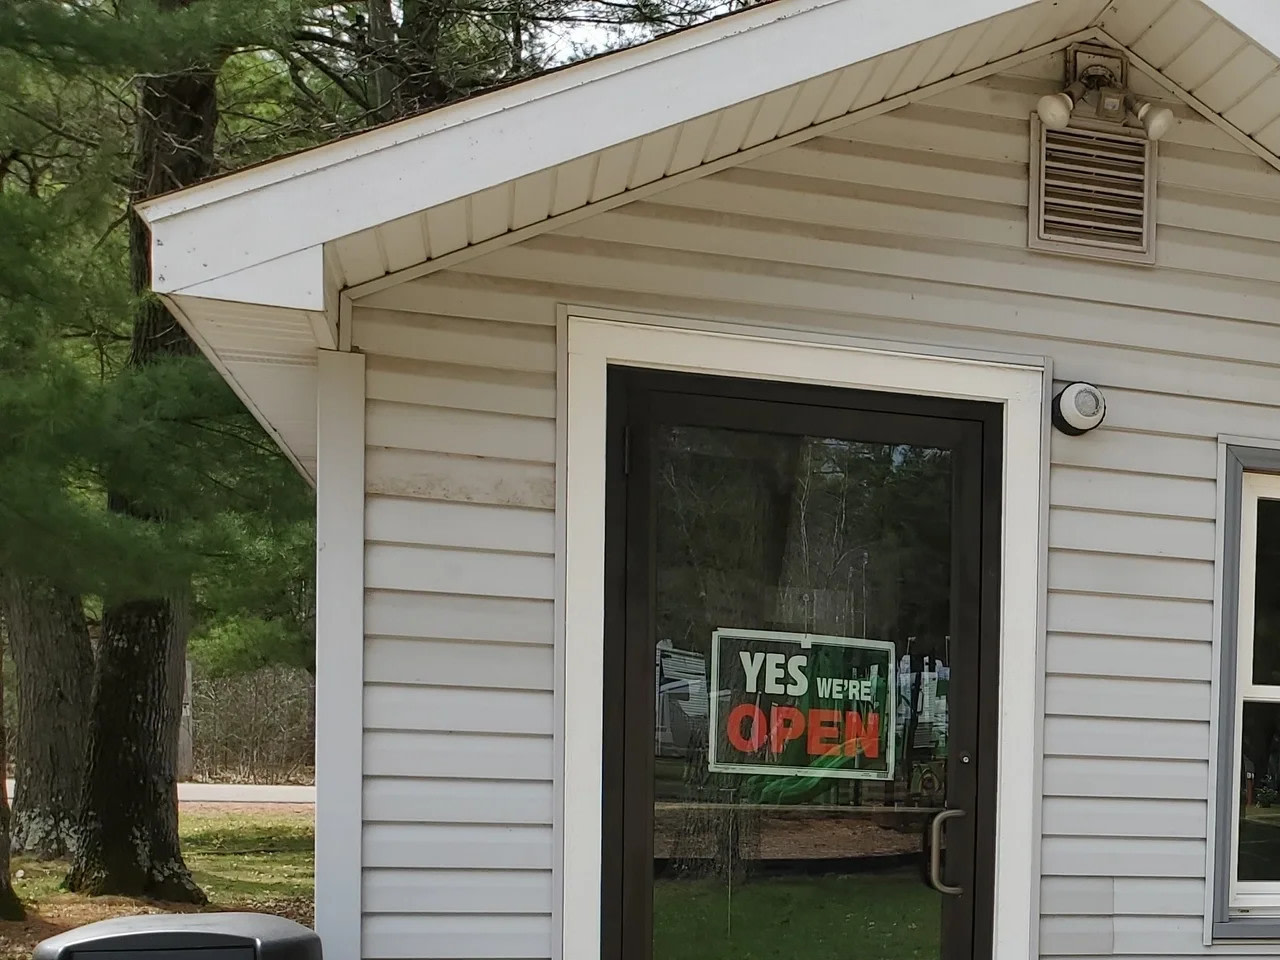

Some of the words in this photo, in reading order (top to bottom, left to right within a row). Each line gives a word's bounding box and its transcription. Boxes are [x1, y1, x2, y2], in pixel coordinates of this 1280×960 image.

[739, 651, 808, 696] YES
[816, 677, 872, 701] WE'RE
[727, 703, 879, 758] OPEN
